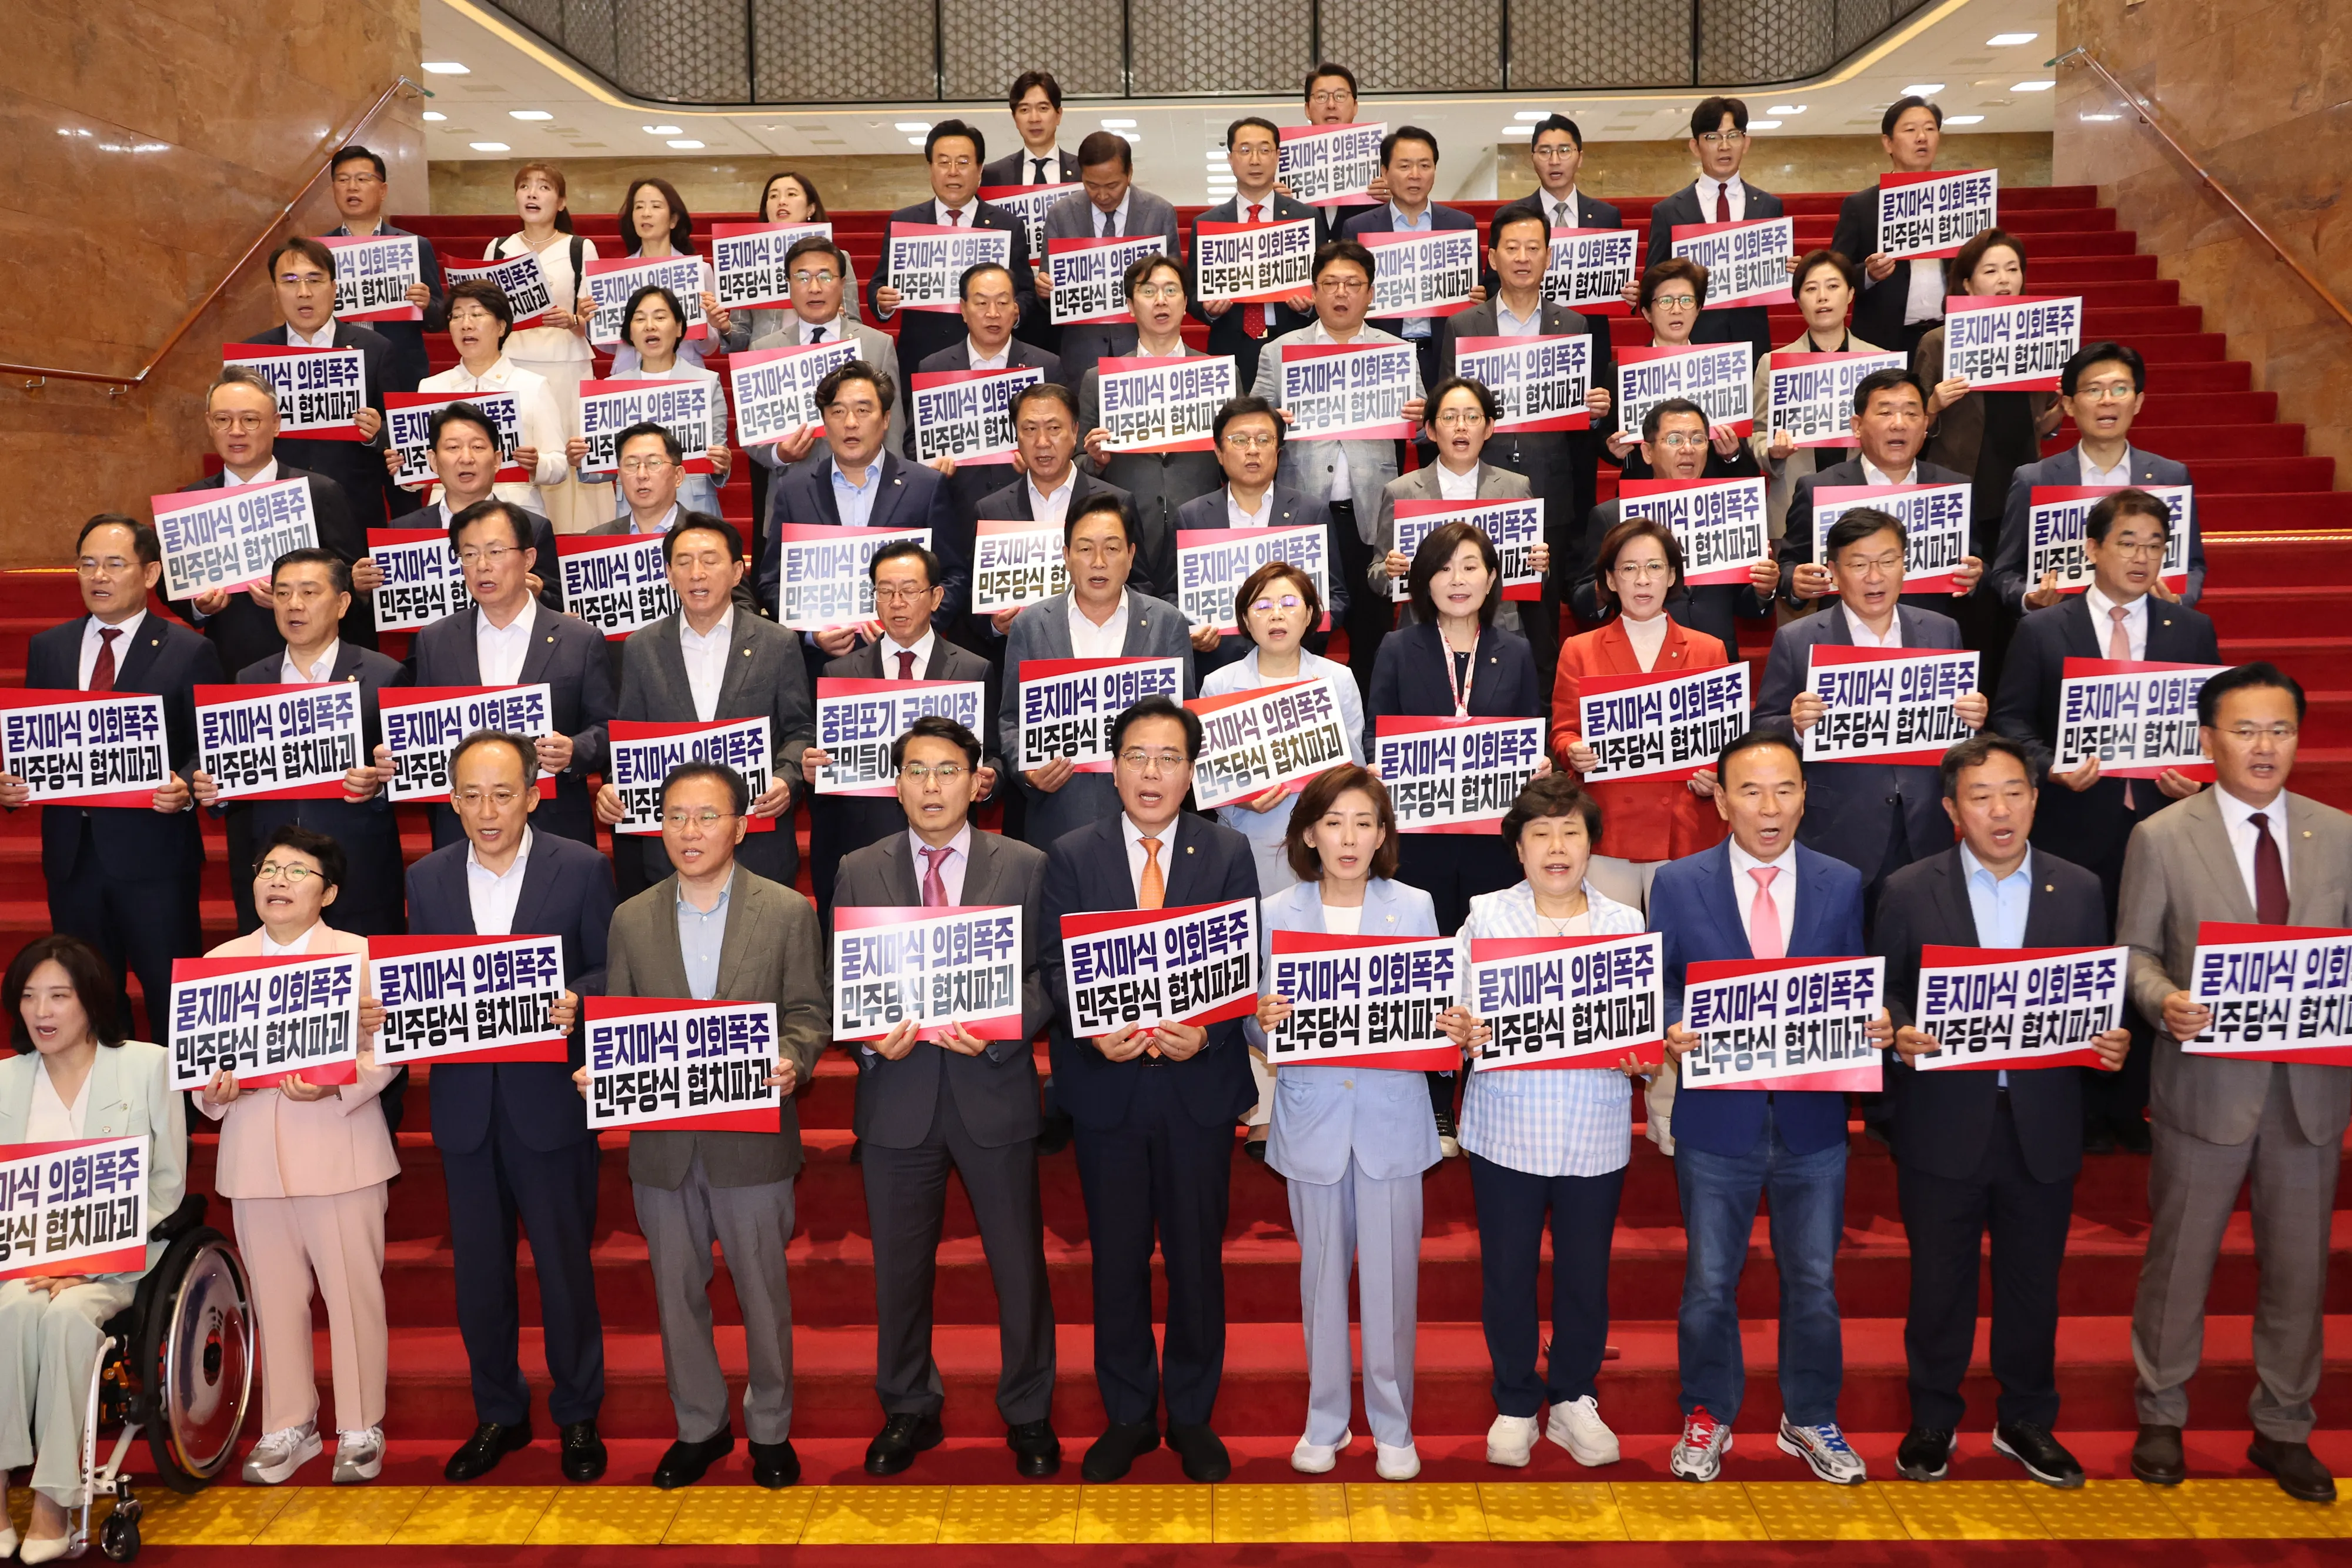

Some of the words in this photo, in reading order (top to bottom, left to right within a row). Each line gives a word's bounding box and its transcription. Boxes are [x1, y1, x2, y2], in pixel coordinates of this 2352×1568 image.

[1278, 139, 1328, 173] 묻지마식
[1332, 129, 1383, 163] 의회폭주
[1883, 186, 1934, 223] 묻지마식
[1938, 176, 1992, 213] 의회폭주
[1201, 236, 1254, 267] 묻지마식
[1258, 225, 1310, 260] 의회폭주
[1734, 225, 1788, 262] 의회폭주
[1882, 217, 1934, 253] 민주당식
[1938, 208, 1992, 244] 협치파괴
[359, 243, 414, 277] 의회폭주
[717, 238, 770, 272] 묻지마식
[893, 240, 947, 270] 묻지마식
[950, 238, 1005, 268] 의회폭주
[1053, 252, 1106, 287] 묻지마식
[1371, 245, 1416, 280] 지마식
[1419, 237, 1473, 272] 의회폭주
[1576, 237, 1632, 269] 의회폭주
[590, 272, 644, 309] 묻지마식
[719, 268, 771, 303] 민주당식
[892, 270, 946, 301] 민주당식
[1201, 265, 1254, 296] 민주당식
[1258, 255, 1311, 289] 협치파괴
[1369, 276, 1416, 312] 주당식
[1420, 268, 1474, 303] 협치파괴
[1575, 268, 1630, 300] 협치파괴
[1705, 267, 1731, 300] 당식
[1735, 256, 1789, 293] 협치파괴
[509, 282, 550, 316] 치파괴
[1054, 283, 1107, 317] 민주당식
[1950, 312, 2011, 349] 묻지마식
[2014, 305, 2075, 341] 의회폭주
[297, 357, 360, 390] 의회폭주
[1286, 360, 1346, 399] 묻지마식
[1350, 351, 1411, 389] 의회폭주
[1525, 342, 1586, 381] 의회폭주
[1622, 362, 1681, 402] 묻지마식
[1686, 350, 1747, 390] 의회폭주
[1949, 346, 2010, 383] 민주당식
[2014, 338, 2074, 376] 협치파괴
[736, 362, 797, 405] 묻지마식
[1104, 373, 1164, 412] 묻지마식
[1170, 363, 1230, 403] 의회폭주
[1526, 376, 1586, 416] 협치파괴
[1773, 368, 1834, 406] 묻지마식
[298, 390, 361, 424] 협치파괴
[584, 396, 642, 433] 묻지마식
[647, 387, 706, 424] 의회폭주
[741, 395, 801, 438] 민주당식
[918, 386, 978, 427] 묻지마식
[1105, 407, 1165, 446] 민주당식
[1287, 394, 1346, 432] 민주당식
[1351, 386, 1411, 424] 협치파괴
[1772, 402, 1833, 440] 민주당식
[920, 420, 980, 460] 민주당식
[162, 505, 235, 554] 묻지마식
[238, 486, 307, 536] 의회폭주
[1693, 486, 1760, 529] 의회폭주
[2033, 507, 2087, 546] 묻지마
[168, 542, 242, 591] 민주당식
[374, 546, 443, 587] 묻지마식
[786, 544, 854, 583] 묻지마식
[980, 534, 1047, 569] 묻지마식
[1183, 546, 1250, 589] 묻지마식
[1694, 524, 1762, 567] 협치파괴
[564, 553, 630, 596] 묻지마식
[634, 545, 666, 583] 의회
[978, 566, 1045, 604] 민주당식
[379, 583, 446, 623] 민주당식
[785, 581, 853, 620] 민주당식
[1184, 585, 1235, 626] 민주당
[1025, 677, 1097, 724] 묻지마식
[1103, 667, 1176, 711] 의회폭주
[1586, 692, 1662, 738] 묻지마식
[1669, 673, 1743, 724] 의회폭주
[1816, 668, 1893, 711] 묻지마식
[1898, 661, 1976, 703] 의회폭주
[2063, 681, 2141, 723] 묻지마식
[6, 710, 82, 754] 묻지마식
[88, 704, 160, 745] 의회폭주
[200, 704, 273, 751] 묻지마식
[278, 692, 354, 739] 의회폭주
[387, 706, 463, 752] 묻지마식
[468, 693, 544, 741] 의회폭주
[822, 700, 896, 743] 중립포기
[1262, 686, 1334, 737] 의회폭주
[1813, 709, 1890, 751] 민주당식
[204, 745, 278, 791] 민주당식
[281, 734, 356, 781] 협치파괴
[691, 727, 764, 771] 의회폭주
[1025, 717, 1097, 764] 민주당식
[1195, 744, 1270, 798] 민주당식
[1269, 723, 1344, 776] 협치파괴
[1381, 736, 1456, 781] 묻지마식
[1461, 728, 1537, 771] 의회폭주
[1589, 730, 1664, 775] 민주당식
[1670, 714, 1746, 764] 협치파괴
[2060, 722, 2137, 764] 민주당식
[89, 745, 163, 787] 협치파괴
[391, 748, 455, 791] 민주당
[841, 930, 925, 981] 묻지마식
[932, 917, 1014, 969] 의회폭주
[1071, 931, 1159, 985] 묻지마식
[1165, 910, 1250, 970] 의회폭주
[379, 957, 466, 1008] 묻지마식
[472, 946, 558, 995] 의회폭주
[1075, 977, 1162, 1029] 민주당식
[1167, 954, 1253, 1016] 협치파괴
[1275, 958, 1360, 1006] 묻지마식
[1367, 949, 1454, 997] 의회폭주
[1479, 959, 1563, 1013] 묻지마식
[1571, 944, 1655, 999] 의회폭주
[1925, 971, 2019, 1015] 묻지마식
[2024, 959, 2117, 1009] 의회폭주
[2199, 950, 2298, 997] 묻지마식
[176, 978, 261, 1032] 묻지마식
[266, 964, 352, 1017] 의회폭주
[841, 976, 925, 1029] 민주당식
[932, 965, 1014, 1018] 협치파괴
[1690, 980, 1778, 1029] 묻지마식
[1785, 968, 1874, 1017] 의회폭주
[383, 1001, 469, 1052] 민주당식
[475, 991, 561, 1041] 협치파괴
[593, 1019, 679, 1071] 묻지마식
[686, 1012, 770, 1059] 의회폭주
[1480, 1006, 1565, 1060] 민주당식
[1572, 992, 1656, 1047] 협치파괴
[2020, 1007, 2114, 1049] 협치파괴
[2194, 998, 2292, 1045] 민주당식
[176, 1025, 258, 1079] 민주당식
[266, 1011, 349, 1065] 협치파괴
[1689, 1024, 1776, 1076] 민주당식
[1785, 1014, 1873, 1066] 협치파괴
[594, 1066, 680, 1118] 민주당식
[687, 1058, 773, 1107] 협치파괴
[47, 1147, 140, 1205] 의회폭주
[46, 1196, 139, 1254] 협치파괴
